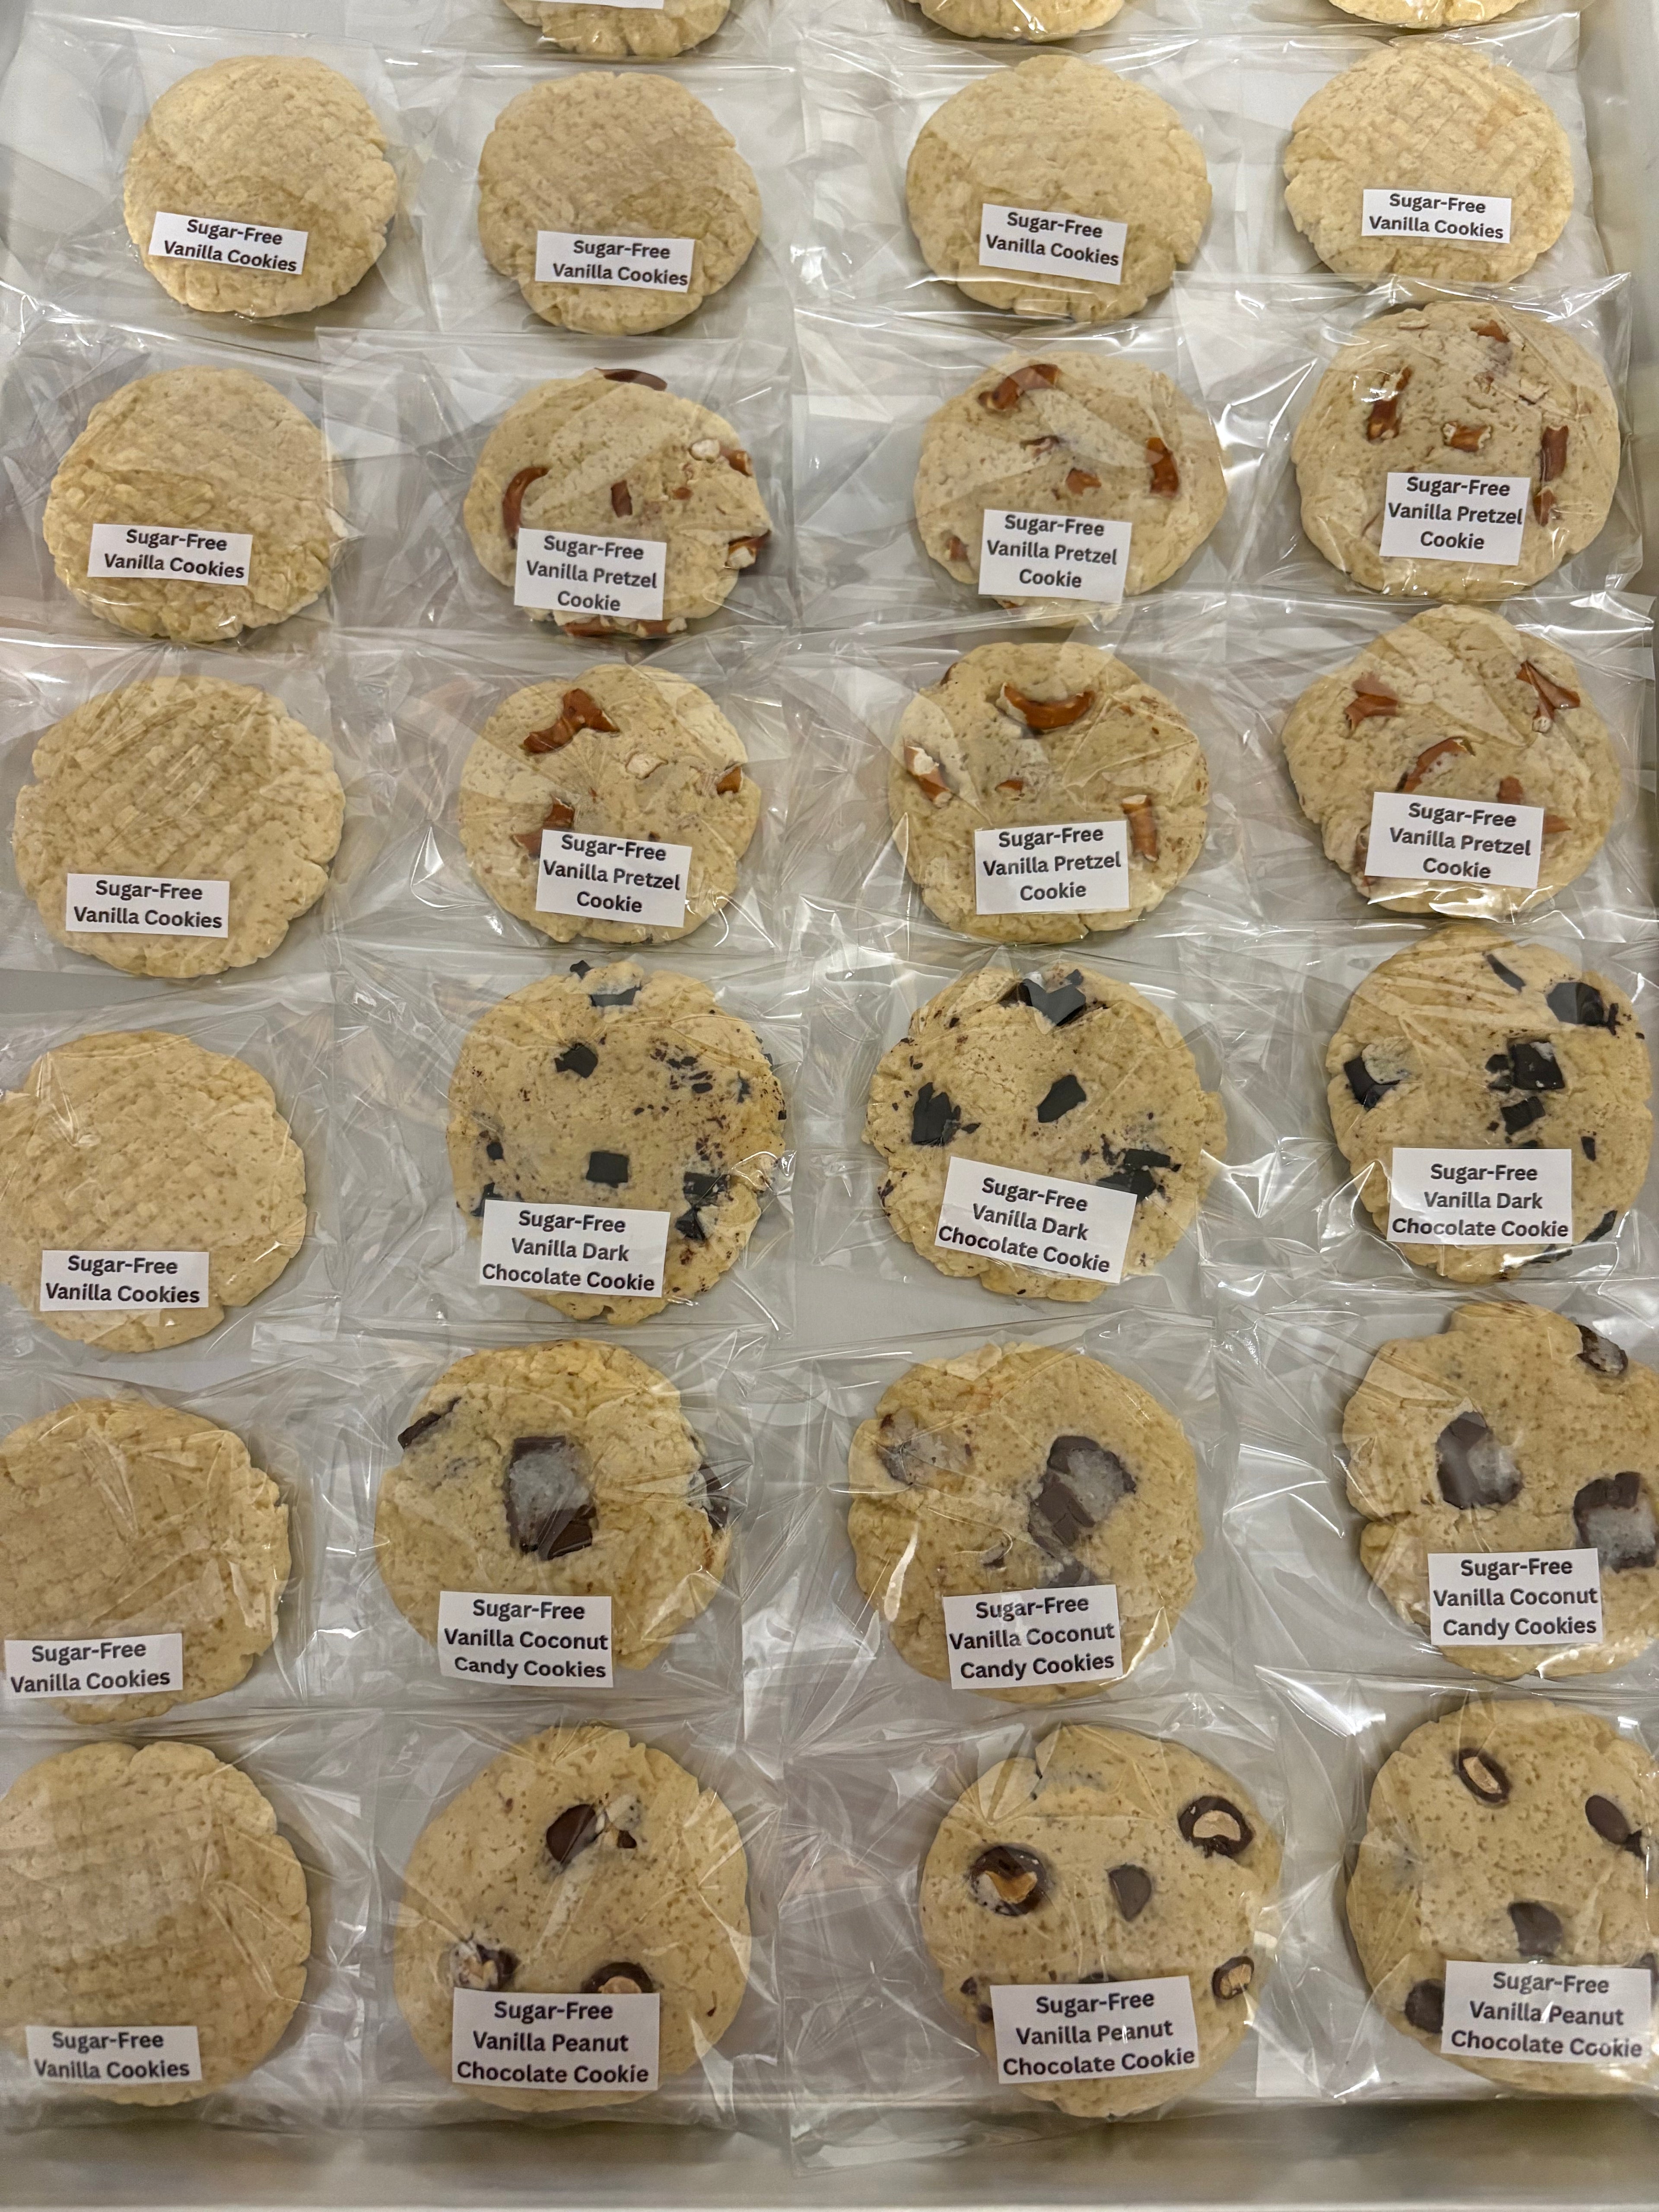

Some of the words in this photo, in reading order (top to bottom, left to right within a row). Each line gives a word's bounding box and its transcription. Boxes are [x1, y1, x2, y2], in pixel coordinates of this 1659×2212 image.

[1389, 193, 1486, 213] Sugar-Free
[187, 218, 283, 245] Sugar-Free
[1007, 212, 1103, 238] Sugar-Free
[1369, 216, 1430, 232] Vanilla
[1434, 219, 1503, 239] Cookies
[164, 241, 223, 262] Vanilla
[227, 249, 297, 273] Cookies
[573, 240, 670, 259] Sugar-Free
[986, 234, 1046, 255] Vanilla
[1051, 243, 1119, 266] Cookies
[553, 263, 613, 280] Vanilla
[617, 267, 688, 286] Cookies
[1406, 476, 1510, 497] Sugar-Free
[1388, 502, 1452, 521] Vanilla
[1457, 506, 1522, 525] Pretzel
[1004, 514, 1104, 537] Sugar-Free
[126, 529, 227, 551] Sugar-Free
[543, 535, 644, 560] Sugar-Free
[1421, 531, 1484, 550] Cookie
[987, 540, 1049, 559] Vanilla
[1055, 544, 1117, 565] Pretzel
[104, 553, 165, 570] Vanilla
[170, 557, 245, 578] Cookies
[526, 560, 588, 582] Vanilla
[593, 568, 657, 589] Pretzel
[1019, 569, 1082, 588] Cookie
[557, 591, 620, 612] Cookie
[1408, 802, 1517, 827] Sugar-Free
[560, 834, 667, 862] Sugar-Free
[998, 827, 1104, 850] Sugar-Free
[1389, 827, 1456, 849] Vanilla
[1461, 835, 1531, 856] Pretzel
[543, 859, 608, 882] Vanilla
[613, 868, 680, 891] Pretzel
[983, 857, 1049, 876] Vanilla
[1054, 851, 1121, 872] Pretzel
[1423, 858, 1491, 879] Cookie
[95, 880, 203, 901] Sugar-Free
[577, 891, 642, 913] Cookie
[1020, 881, 1087, 901] Cookie
[74, 906, 140, 925] Vanilla
[145, 909, 222, 928] Cookies
[1430, 1163, 1538, 1185] Sugar-Free
[982, 1177, 1088, 1214] Sugar-Free
[1424, 1191, 1491, 1208] Vanilla
[1497, 1192, 1543, 1209] Dark
[518, 1210, 626, 1233] Sugar-Free
[973, 1203, 1037, 1231] Vanilla
[1042, 1217, 1089, 1241] Dark
[1392, 1217, 1496, 1236] Chocolate
[1501, 1220, 1569, 1237] Cookie
[512, 1237, 577, 1258] Vanilla
[582, 1243, 629, 1262] Dark
[938, 1225, 1039, 1260] Chocolate
[1043, 1246, 1109, 1273] Cookie
[67, 1255, 178, 1277] Sugar-Free
[483, 1263, 581, 1288] Chocolate
[587, 1271, 655, 1291] Cookie
[45, 1282, 112, 1301] Vanilla
[118, 1285, 200, 1303] Cookies
[1461, 1558, 1573, 1581] Sugar-Free
[976, 1596, 1089, 1622] Sugar-Free
[1433, 1588, 1505, 1607] Vanilla
[1510, 1588, 1598, 1605] Coconut
[473, 1599, 585, 1622] Sugar-Free
[444, 1628, 515, 1647] Vanilla
[520, 1631, 608, 1650] Coconut
[949, 1630, 1021, 1650] Vanilla
[1026, 1623, 1115, 1645] Coconut
[1443, 1618, 1510, 1640] Candy
[1515, 1616, 1597, 1635] Cookies
[32, 1642, 146, 1666] Sugar-Free
[454, 1656, 518, 1679] Candy
[524, 1660, 606, 1678] Cookies
[960, 1659, 1027, 1681] Candy
[1033, 1653, 1114, 1675] Cookies
[10, 1673, 81, 1693] Vanilla
[86, 1669, 171, 1690] Cookies
[1493, 1971, 1609, 1995] Sugar-Free
[494, 2001, 613, 2024] Sugar-Free
[1036, 1993, 1154, 2018] Sugar-Free
[1469, 2000, 1541, 2022] Vanilla
[1548, 2005, 1624, 2026] Peanut
[52, 2031, 164, 2054] Sugar-Free
[473, 2031, 546, 2052] Vanilla
[553, 2034, 629, 2052] Peanut
[1016, 2025, 1092, 2045] Vanilla
[1097, 2020, 1173, 2042] Peanut
[1451, 2030, 1564, 2054] Chocolate
[1570, 2037, 1642, 2057] Cookie
[34, 2059, 101, 2079] Vanilla
[107, 2060, 190, 2079] Cookies
[457, 2061, 567, 2083] Chocolate
[574, 2064, 648, 2083] Cookie
[1003, 2056, 1115, 2075] Chocolate
[1121, 2047, 1195, 2070] Cookie
